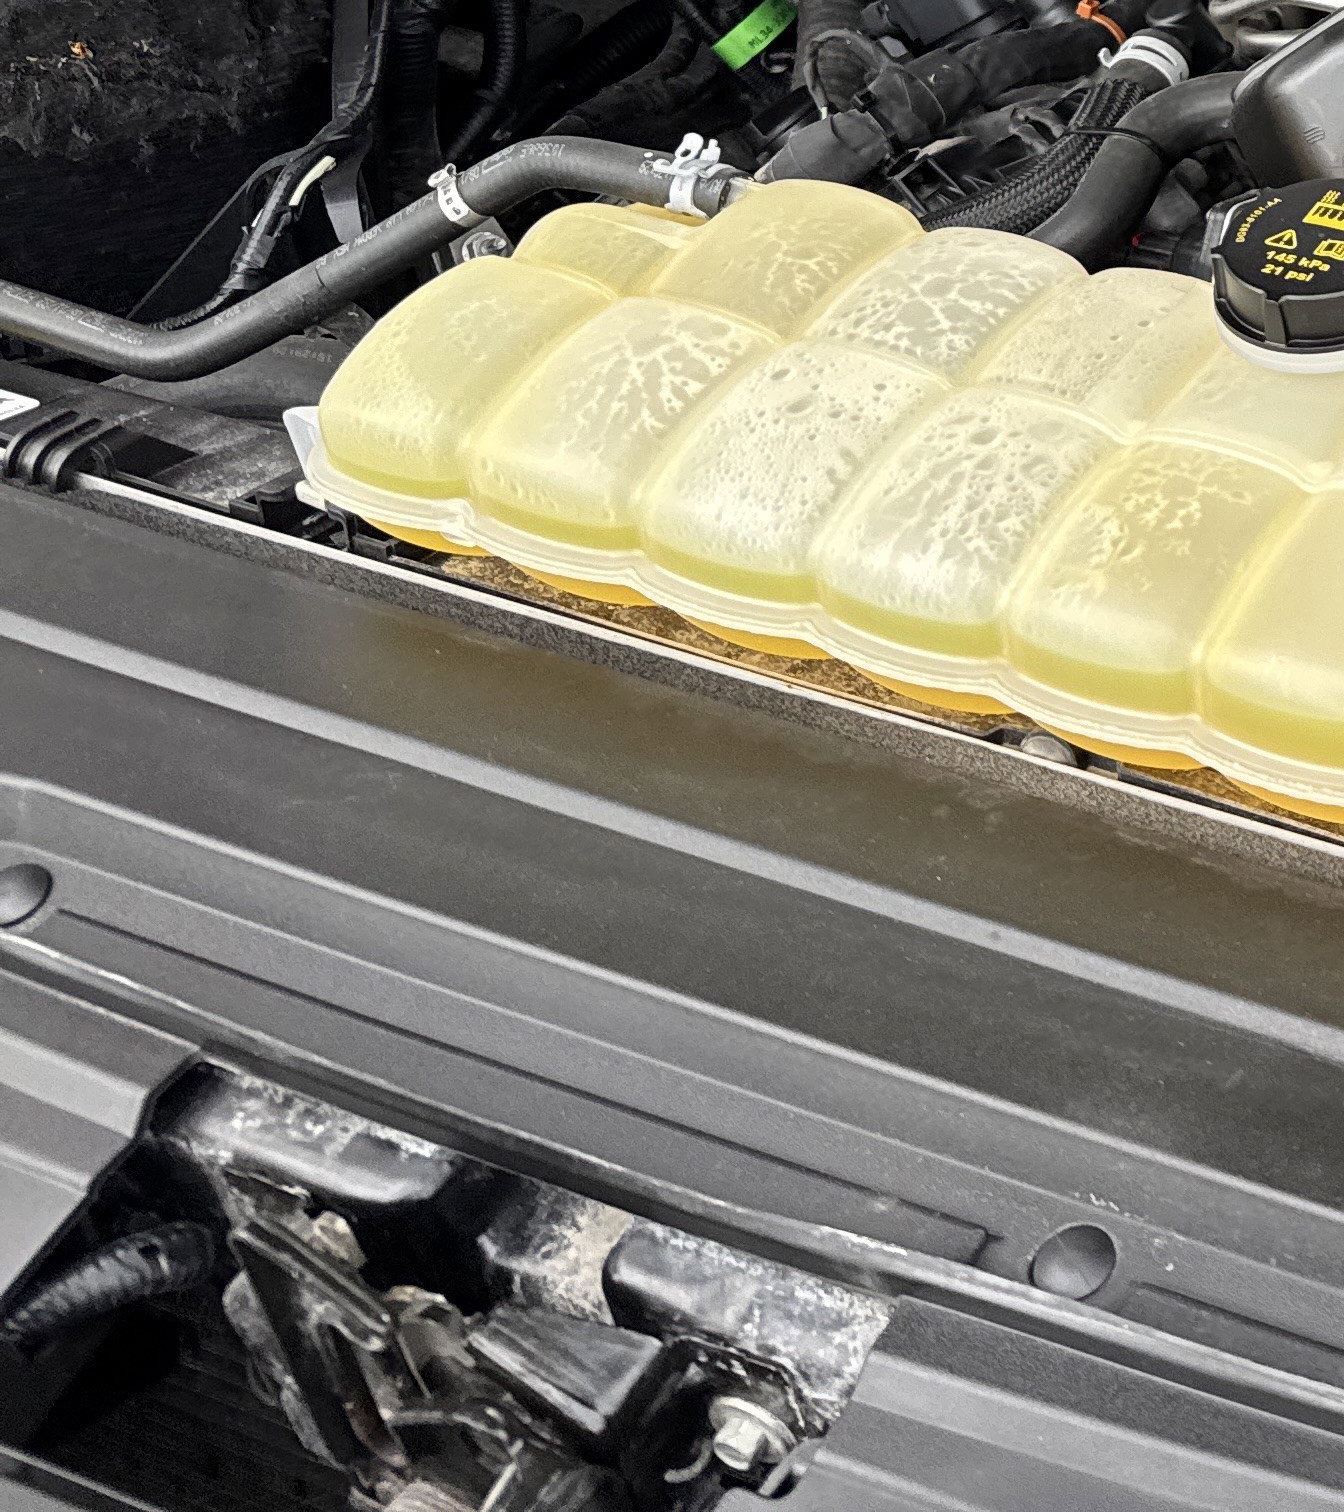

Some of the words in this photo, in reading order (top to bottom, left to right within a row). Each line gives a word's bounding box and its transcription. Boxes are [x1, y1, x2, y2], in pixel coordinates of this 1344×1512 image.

[1266, 250, 1296, 264] 145
[1298, 257, 1331, 272] kPa
[1261, 264, 1283, 276] 21
[1284, 269, 1314, 283] psi
